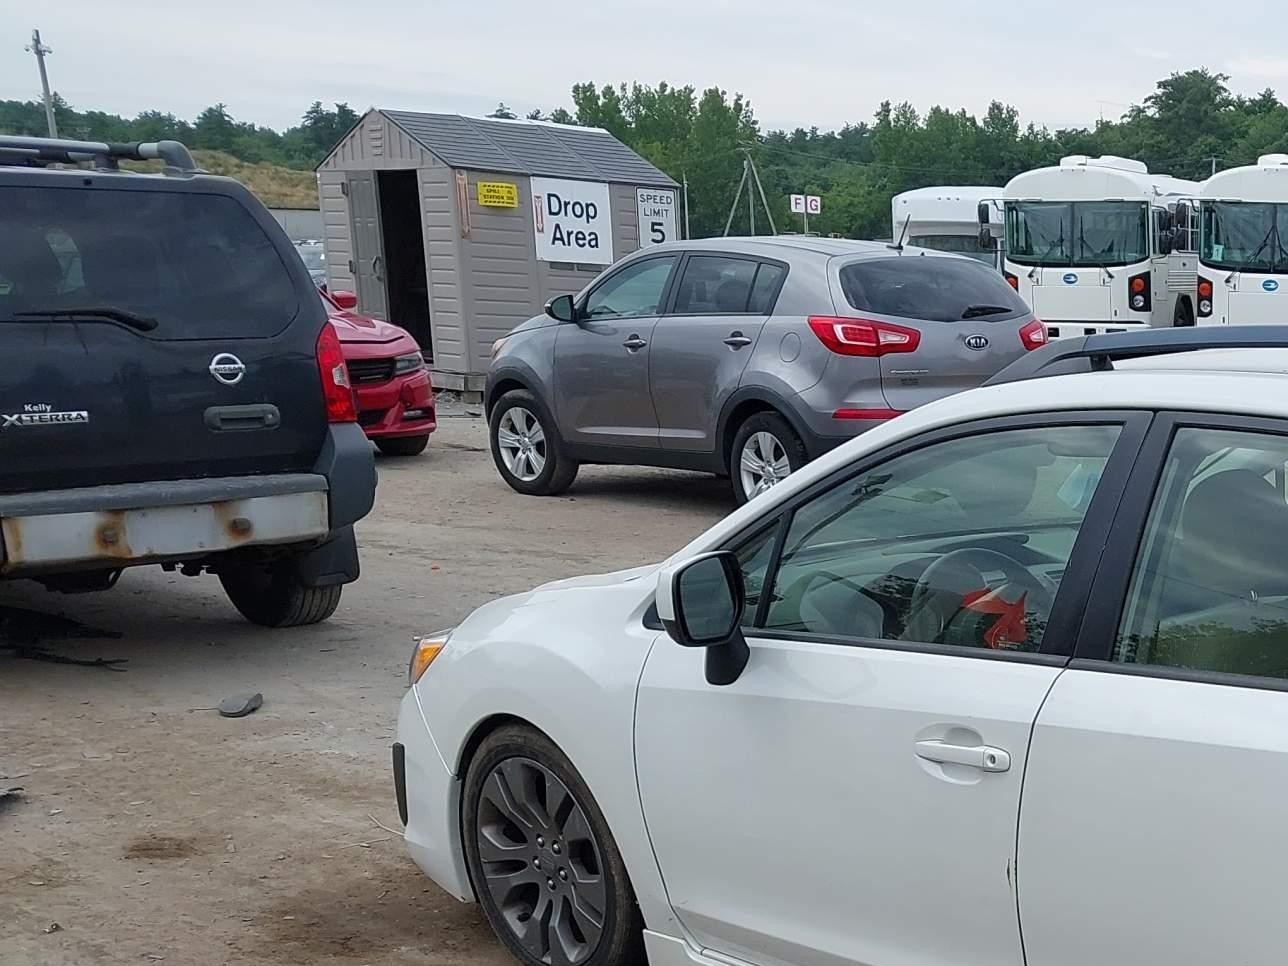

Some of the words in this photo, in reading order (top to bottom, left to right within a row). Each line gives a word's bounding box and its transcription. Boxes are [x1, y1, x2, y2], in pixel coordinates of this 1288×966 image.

[639, 193, 673, 205] SPEED
[794, 197, 802, 210] F
[810, 199, 819, 211] G
[547, 193, 598, 224] Drop
[643, 208, 669, 219] LIMIT
[551, 223, 599, 249] Area
[650, 222, 666, 244] 5
[969, 338, 987, 348] KIA
[24, 403, 52, 413] Kelly
[1, 411, 88, 427] XTERRA
